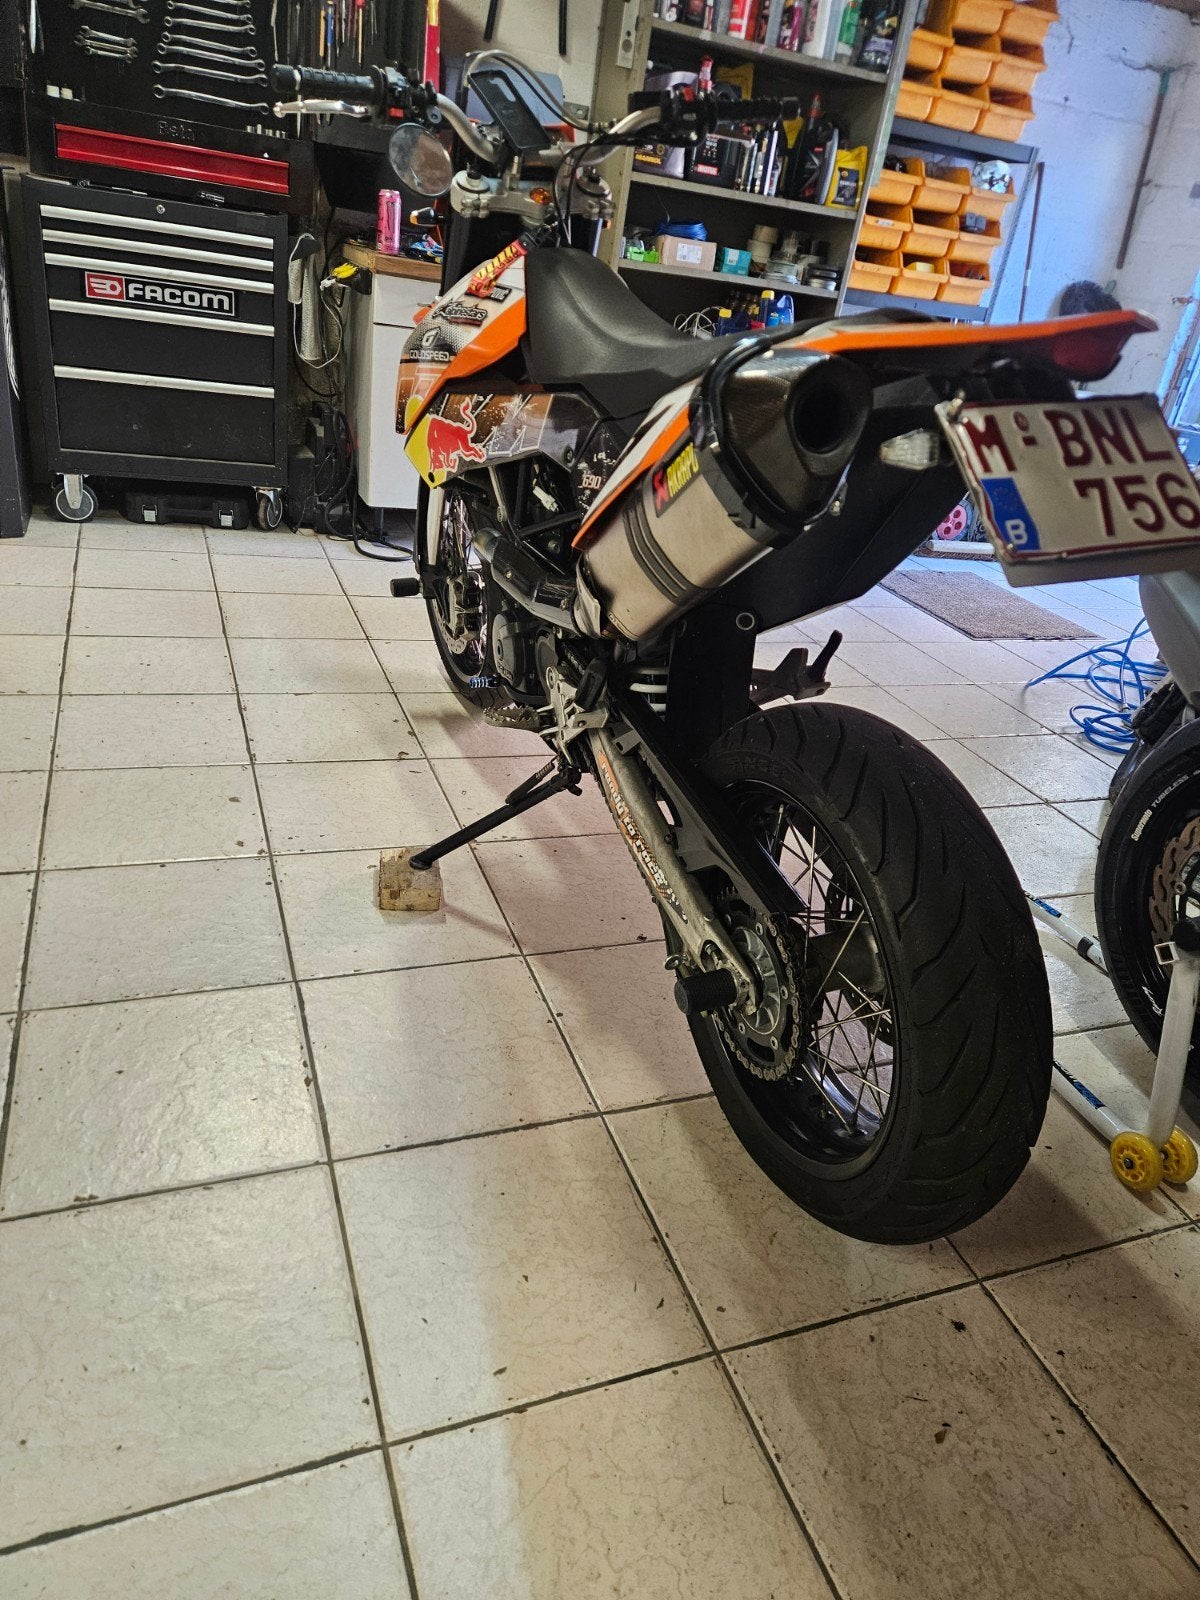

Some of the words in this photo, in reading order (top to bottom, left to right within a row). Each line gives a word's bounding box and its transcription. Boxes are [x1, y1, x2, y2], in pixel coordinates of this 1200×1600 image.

[159, 121, 194, 141] Beta
[128, 282, 230, 311] FACOM
[582, 474, 602, 490] 690
[1073, 472, 1200, 537] 756
[1005, 519, 1028, 545] B
[1130, 808, 1153, 842] Supermoto
[1150, 774, 1189, 808] TUBELESS
[622, 815, 637, 837] to
[635, 838, 665, 887] race
